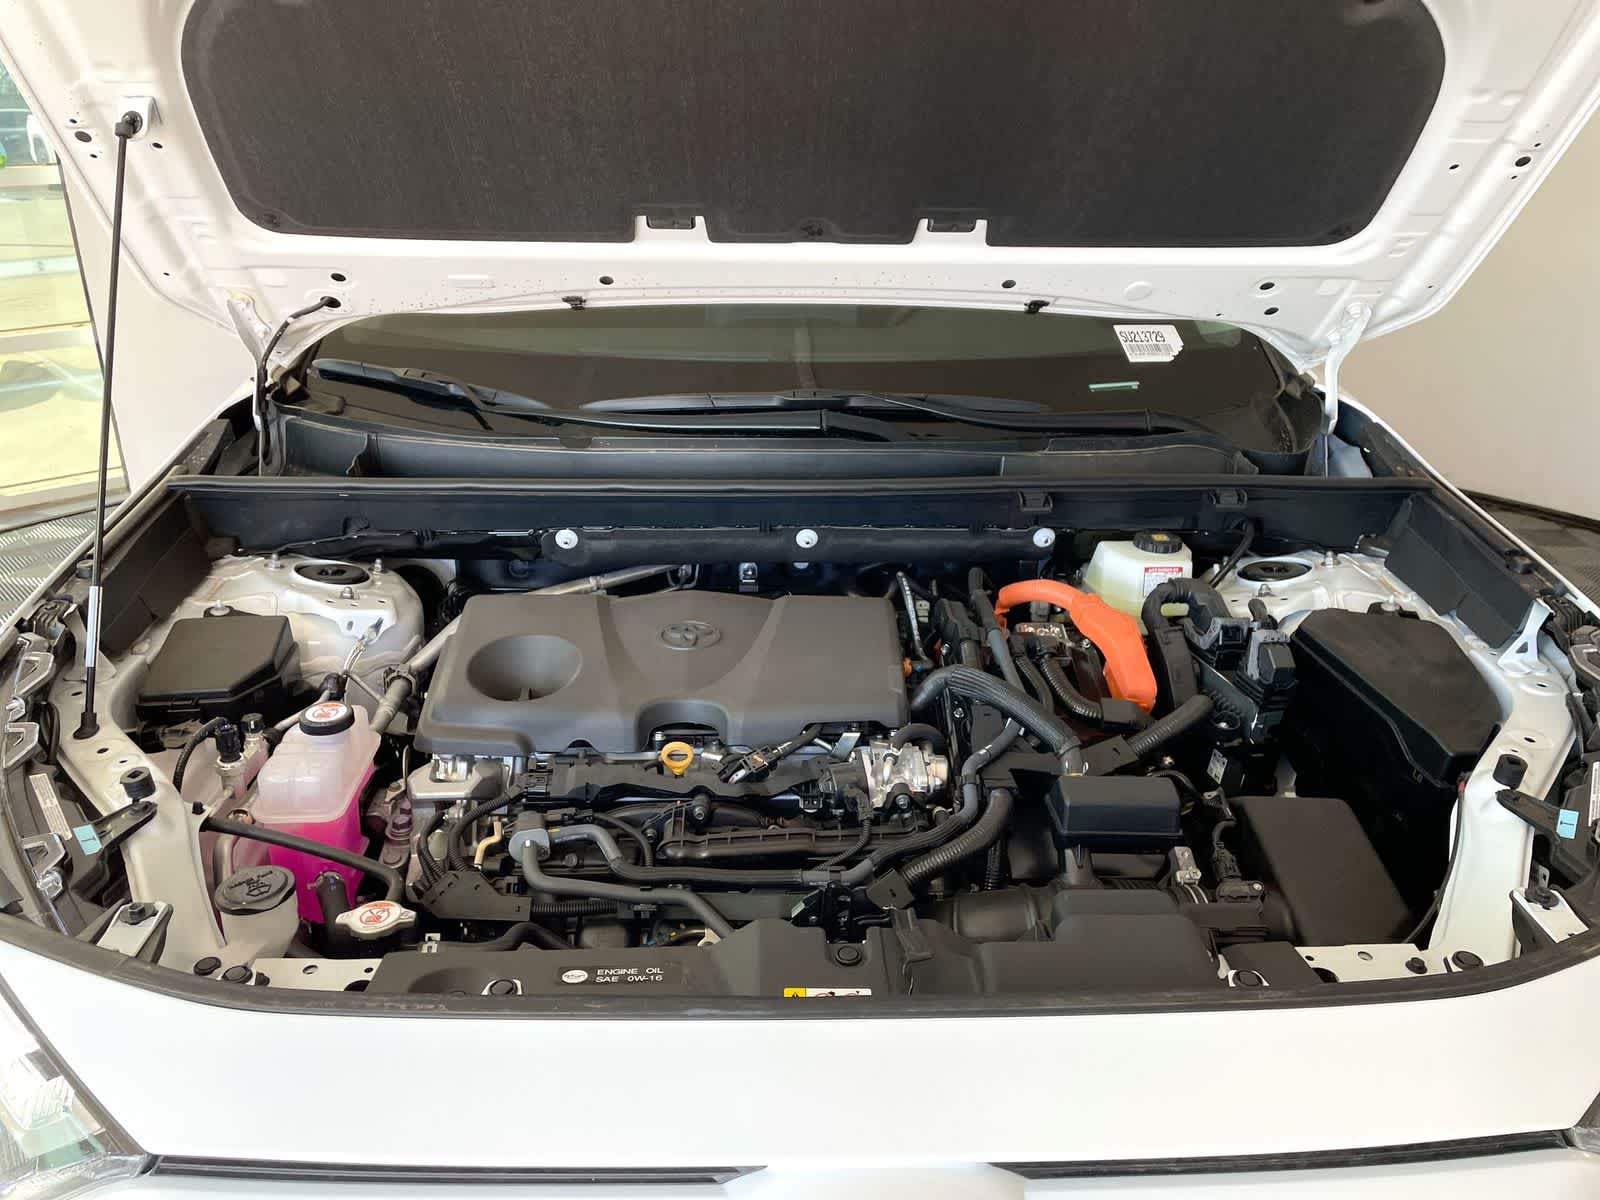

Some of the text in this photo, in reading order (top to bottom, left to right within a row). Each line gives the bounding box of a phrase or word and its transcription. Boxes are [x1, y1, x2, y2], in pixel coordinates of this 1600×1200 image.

[1119, 330, 1166, 343] SU213729
[595, 975, 619, 983] SAE
[627, 974, 663, 982] 0W-16
